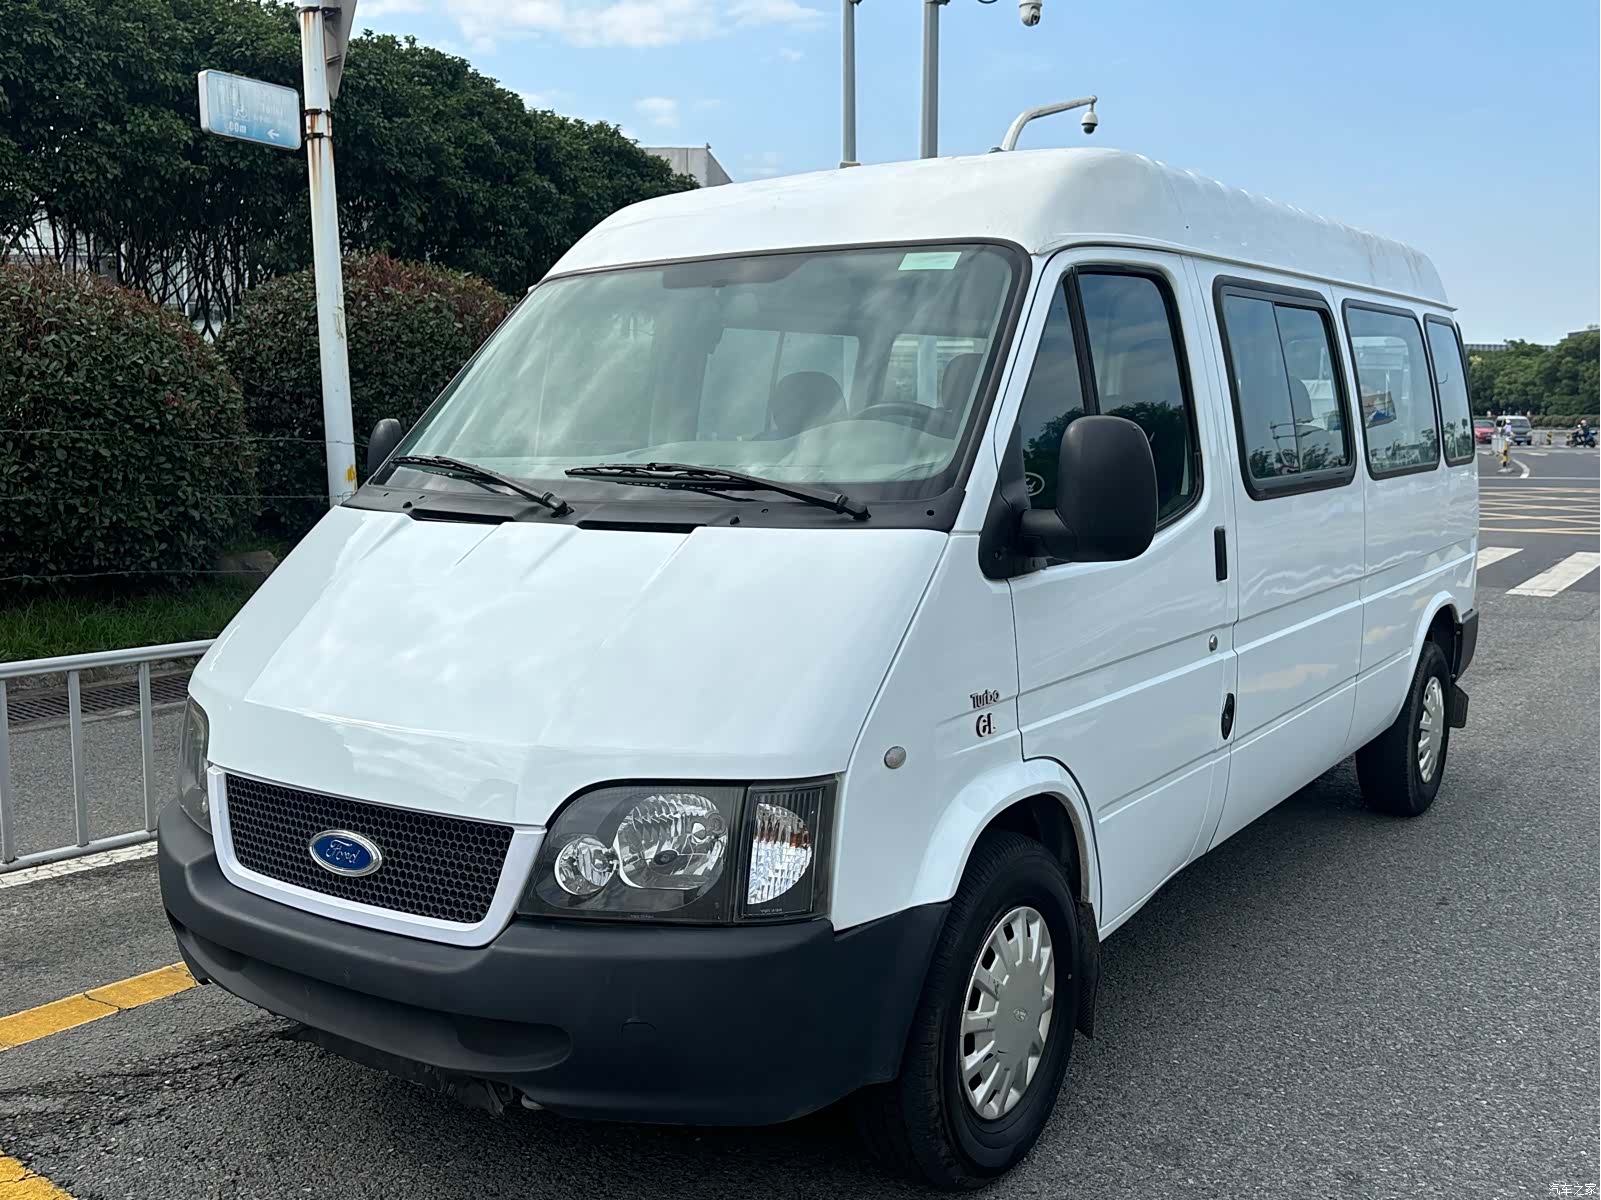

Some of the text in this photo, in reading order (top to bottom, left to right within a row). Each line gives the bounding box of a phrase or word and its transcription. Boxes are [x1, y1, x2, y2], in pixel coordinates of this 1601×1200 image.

[970, 689, 999, 709] Turbo
[976, 713, 996, 737] GL
[325, 839, 360, 864] Ford
